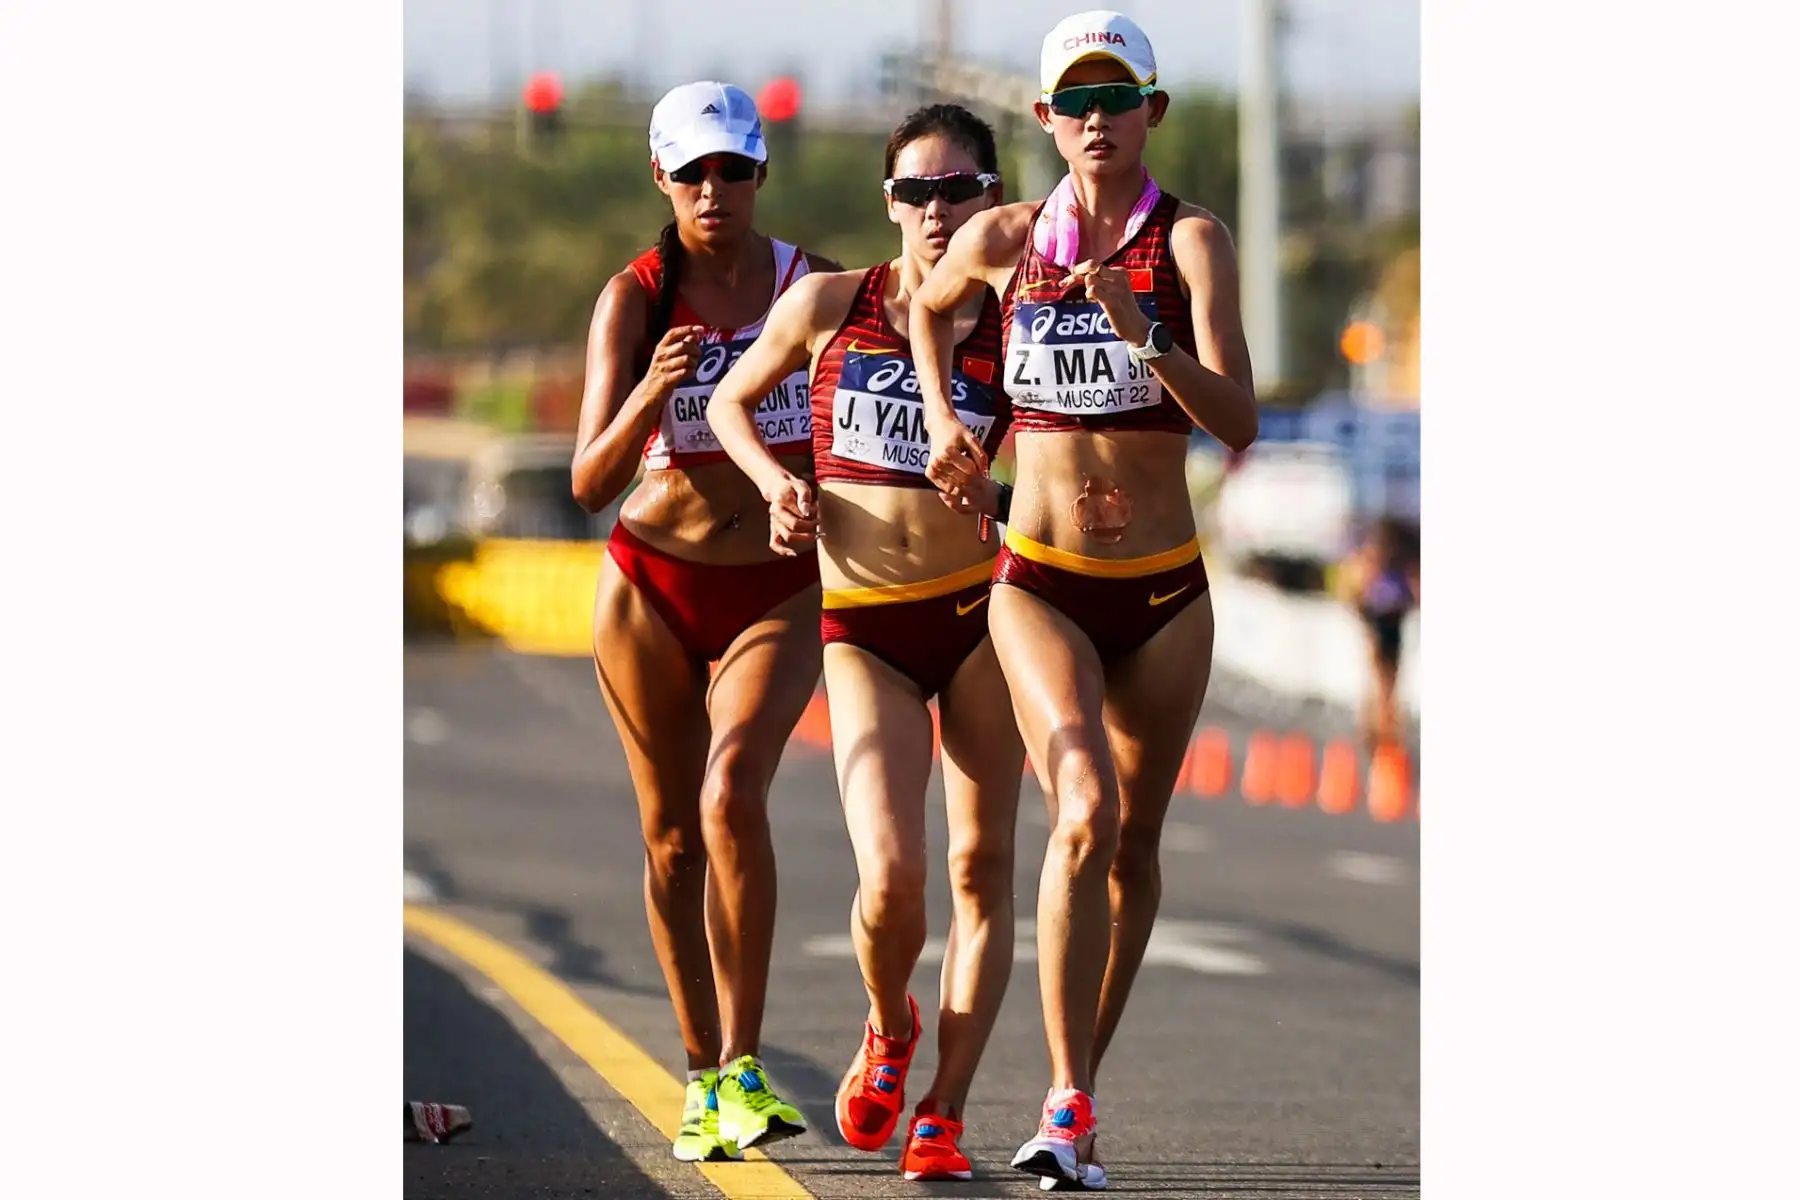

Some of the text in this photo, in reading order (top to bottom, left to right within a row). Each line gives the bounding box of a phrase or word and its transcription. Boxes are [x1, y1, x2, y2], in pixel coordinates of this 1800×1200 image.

[1063, 32, 1127, 50] CHINA
[1056, 312, 1115, 336] asic
[1013, 350, 1041, 385] Z.
[1054, 348, 1116, 385] MA
[1056, 384, 1149, 408] MUSCAT 22
[756, 415, 812, 439] SCAT 2
[839, 396, 860, 432] J.
[876, 400, 929, 444] YAN
[882, 443, 930, 468] MUSC
